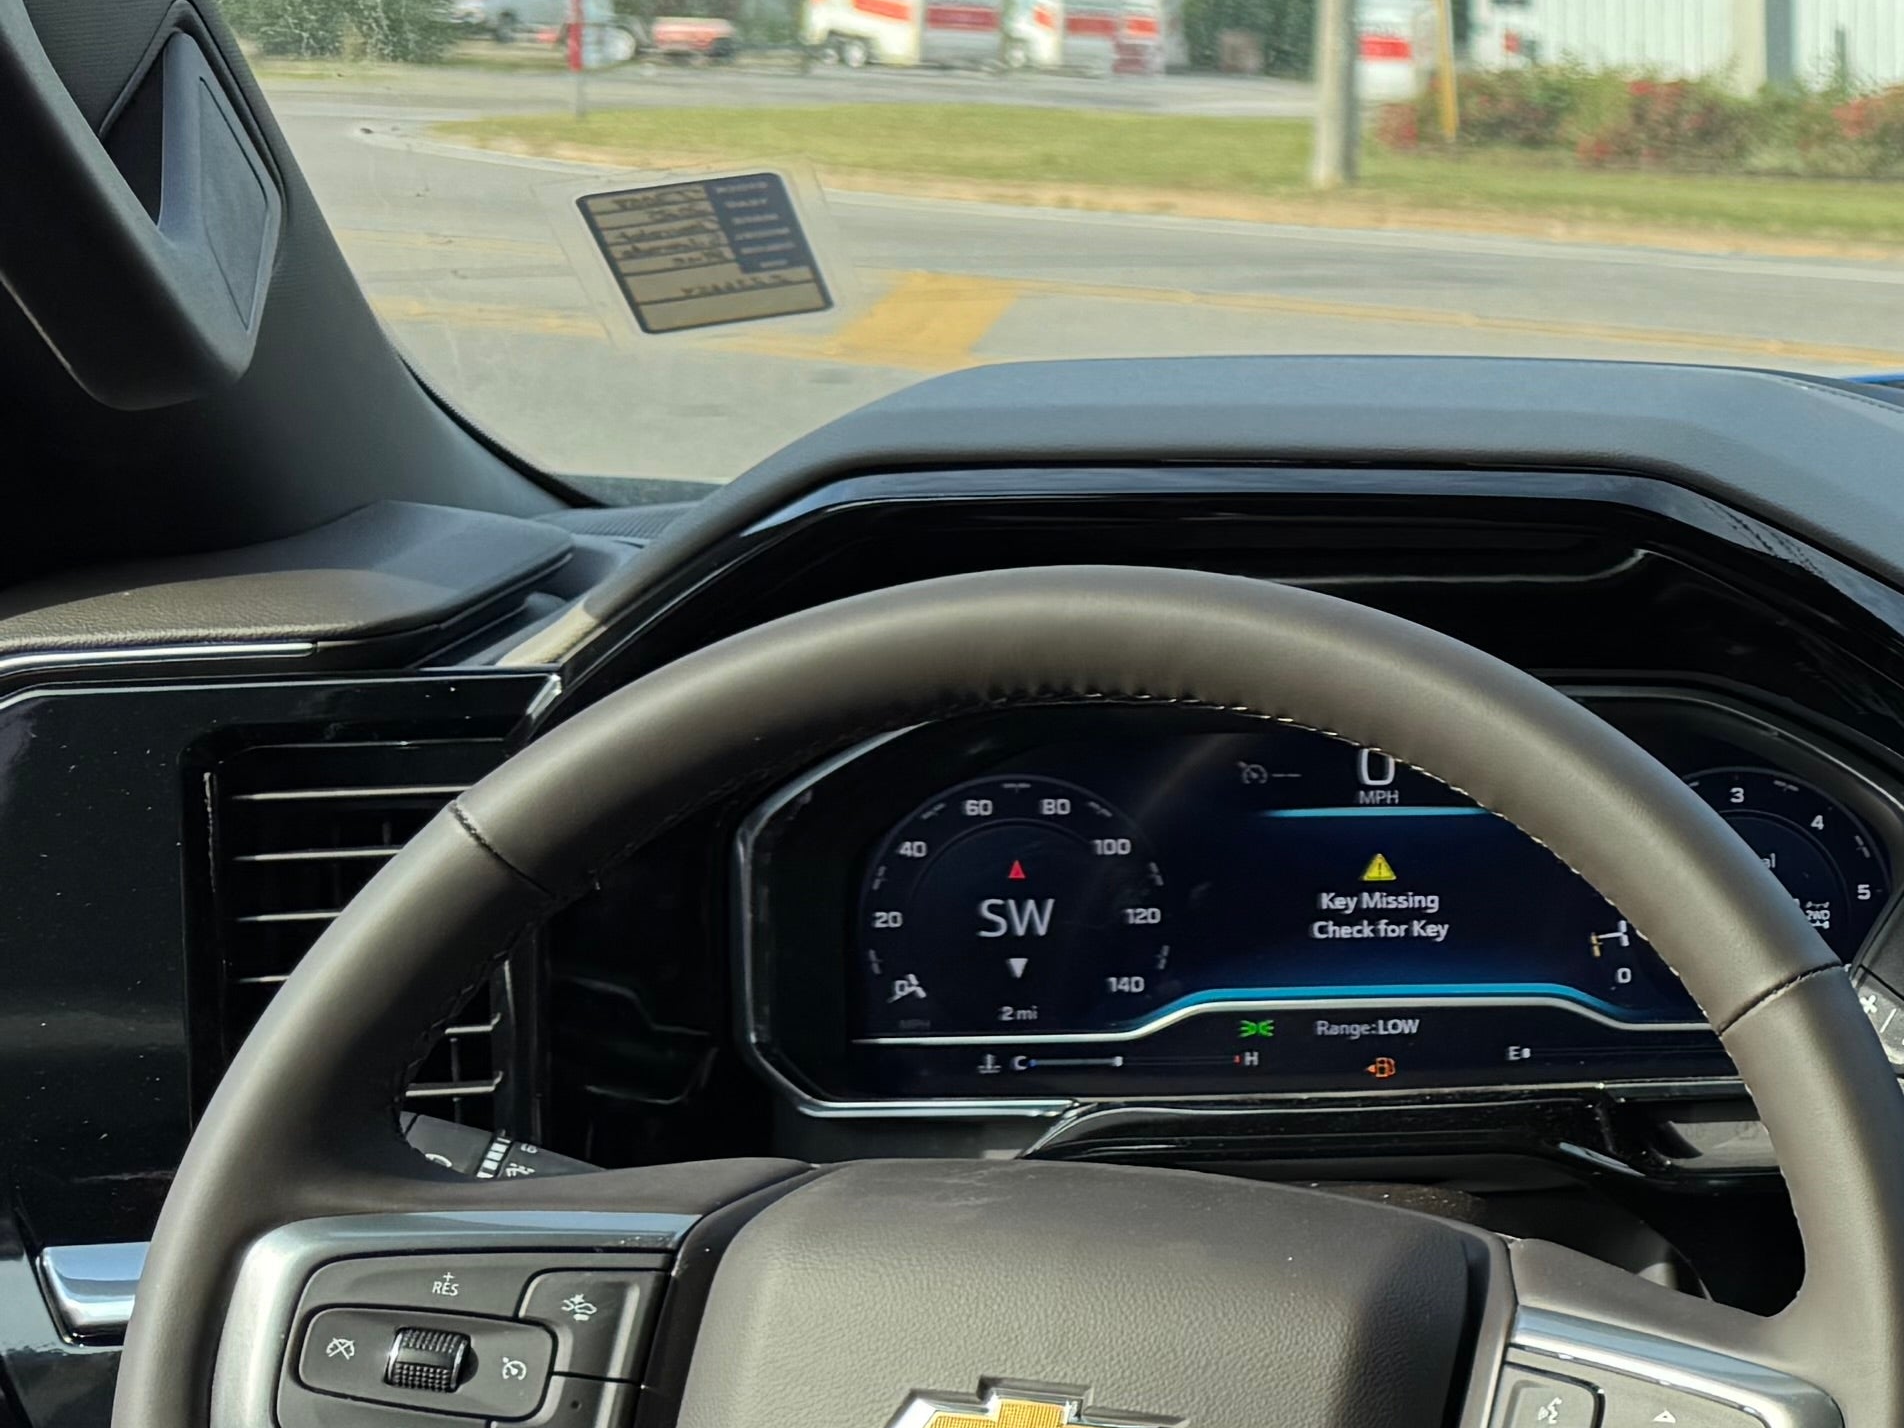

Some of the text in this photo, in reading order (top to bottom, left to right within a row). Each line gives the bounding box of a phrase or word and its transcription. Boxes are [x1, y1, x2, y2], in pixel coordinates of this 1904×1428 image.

[1358, 789, 1400, 805] MPH
[1729, 787, 1745, 804] 3
[963, 798, 993, 816] 60
[1040, 798, 1071, 816] 80
[1810, 814, 1825, 830] 4
[897, 840, 928, 858] 40
[1092, 838, 1131, 856] 100
[1856, 883, 1872, 900] 5
[1319, 891, 1440, 915] Key Missing
[873, 911, 904, 929] 20
[976, 897, 1056, 938] SW
[1124, 907, 1161, 925] 120
[1310, 918, 1450, 942] Check for Key
[1106, 975, 1145, 993] 140
[1616, 967, 1632, 983] 0
[998, 1004, 1039, 1022] 2 mi
[1244, 1051, 1259, 1066] H
[1508, 1046, 1521, 1061] E
[1012, 1055, 1027, 1071] C
[431, 1280, 459, 1297] RES
